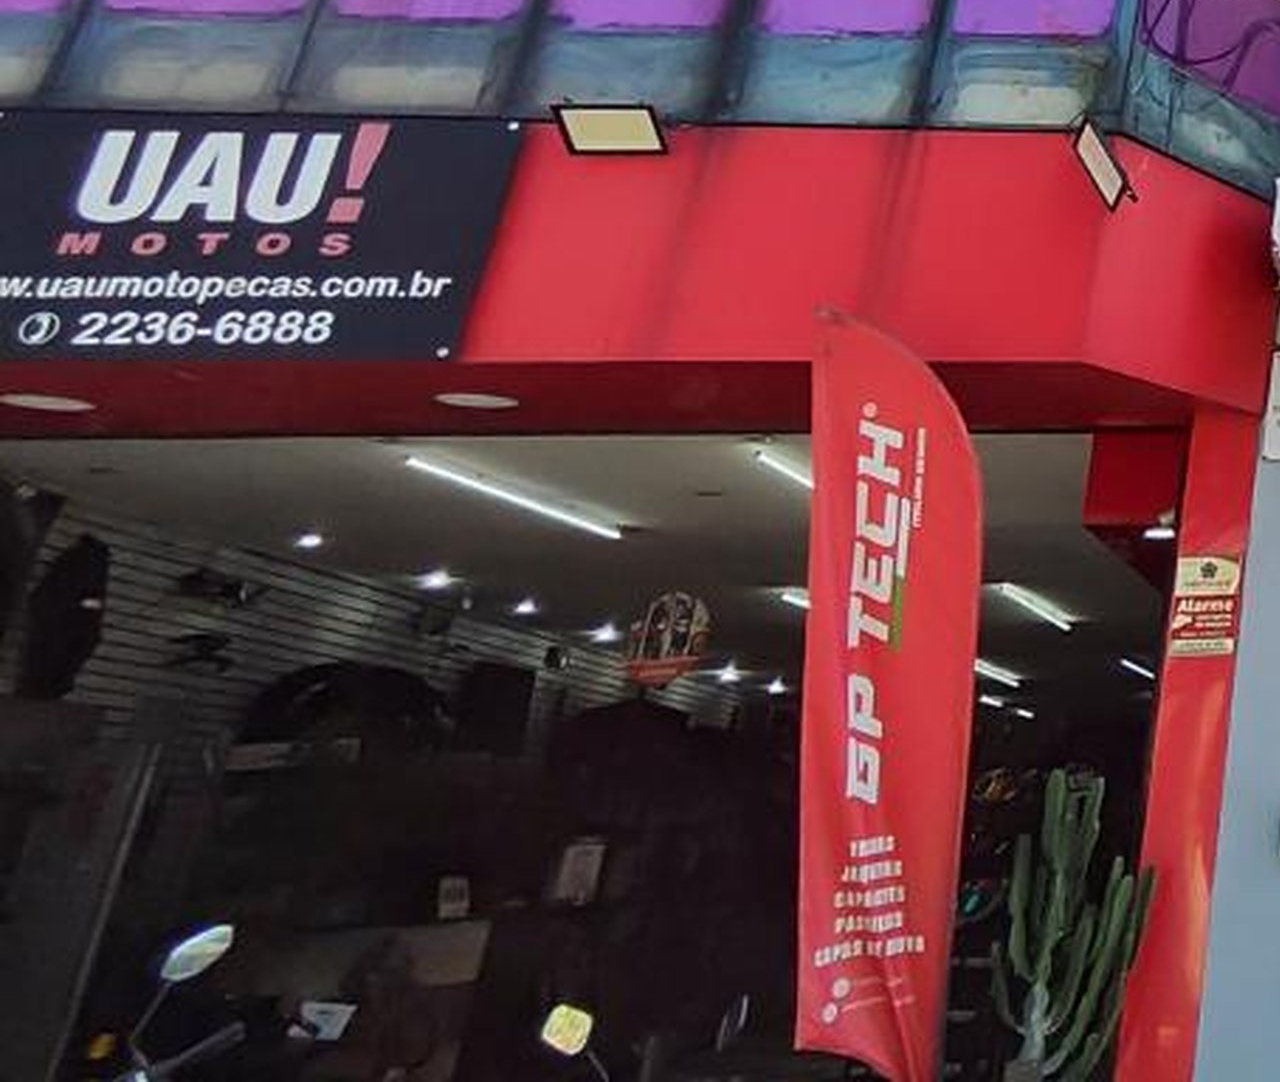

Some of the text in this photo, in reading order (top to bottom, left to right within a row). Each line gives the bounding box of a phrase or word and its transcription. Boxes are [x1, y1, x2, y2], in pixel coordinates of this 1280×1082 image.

[76, 123, 391, 224] UAU!
[56, 232, 352, 256] MOTOS
[71, 311, 334, 345] 2236-6888
[847, 419, 903, 649] TECH
